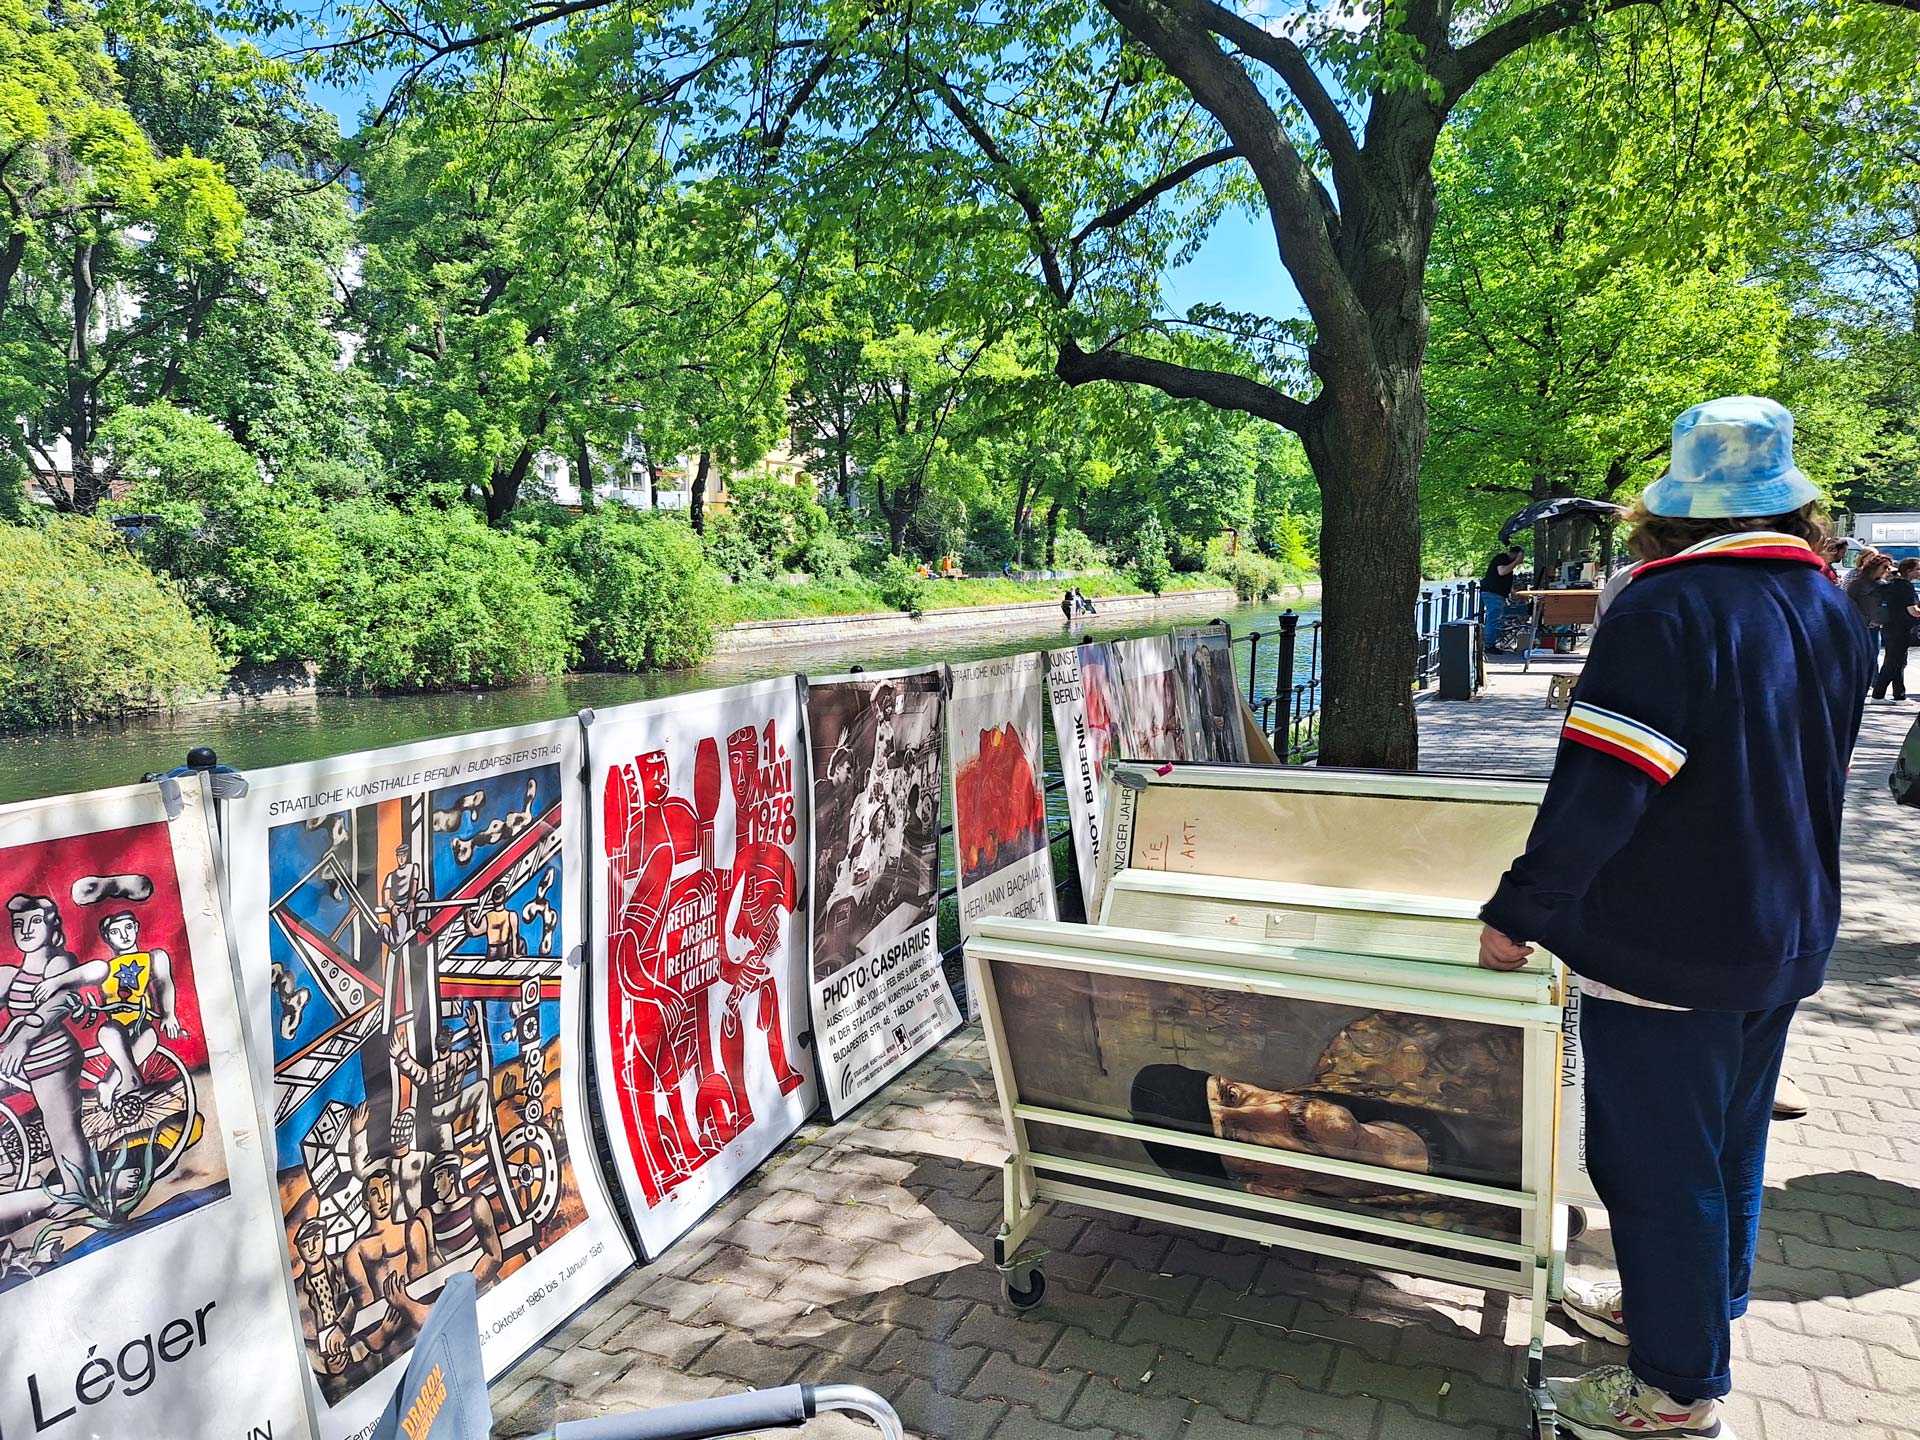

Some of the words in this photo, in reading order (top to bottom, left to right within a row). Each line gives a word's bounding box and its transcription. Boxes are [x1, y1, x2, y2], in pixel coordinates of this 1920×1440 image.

[951, 666, 988, 682] STAATLICHE
[990, 661, 1022, 677] KUNSTHALLE
[1024, 658, 1040, 671] BERLI
[1048, 651, 1077, 668] KUNST-
[1050, 668, 1079, 686] HALLE
[1054, 687, 1085, 705] BERLIN
[763, 718, 785, 764] 1.
[1074, 714, 1093, 803] BUBENIK
[269, 789, 343, 816] STAATLICHE
[347, 772, 421, 799] KUNSTHALLE
[424, 764, 461, 783] BERLIN
[468, 750, 529, 773] BUDAPESTER
[551, 743, 562, 755] 46
[750, 759, 792, 803] MAI
[1122, 785, 1132, 820] JAHR
[1088, 813, 1100, 869] NOT
[667, 901, 699, 933] RECHT
[699, 892, 717, 919] AUF
[964, 884, 1005, 920] HERMANN
[1007, 864, 1050, 897] BACHMANN
[1004, 892, 1044, 918] ENBERICHT
[680, 915, 717, 950] ARBEIT
[667, 945, 700, 979] RECHT
[700, 935, 719, 963] AUF
[681, 957, 720, 994] KULTUR
[822, 965, 870, 1011] PHOTO:
[871, 927, 931, 979] CASPARIUS
[826, 996, 868, 1030] AUSSTELLUNG
[866, 988, 879, 1002] VOM
[897, 972, 905, 983] BIS
[828, 1035, 836, 1047] IN
[838, 1025, 851, 1041] DER
[852, 1001, 887, 1031] STAATLICHEN
[888, 977, 919, 1004] KUNSTHALLE
[920, 966, 936, 983] BERLIN
[832, 1031, 869, 1064] BUDAPESTER
[882, 1015, 891, 1026] 46
[893, 997, 916, 1019] TÄGLICH
[930, 980, 941, 994] UHR
[1562, 985, 1579, 1087] WEIMARER
[479, 1330, 494, 1347] 24.
[492, 1304, 526, 1335] Oktober
[526, 1287, 546, 1308] 1980
[544, 1279, 559, 1293] bis
[566, 1253, 589, 1279] Januar
[589, 1241, 605, 1259] 1981
[27, 1300, 216, 1433] Léger
[344, 1416, 381, 1440] ernan
